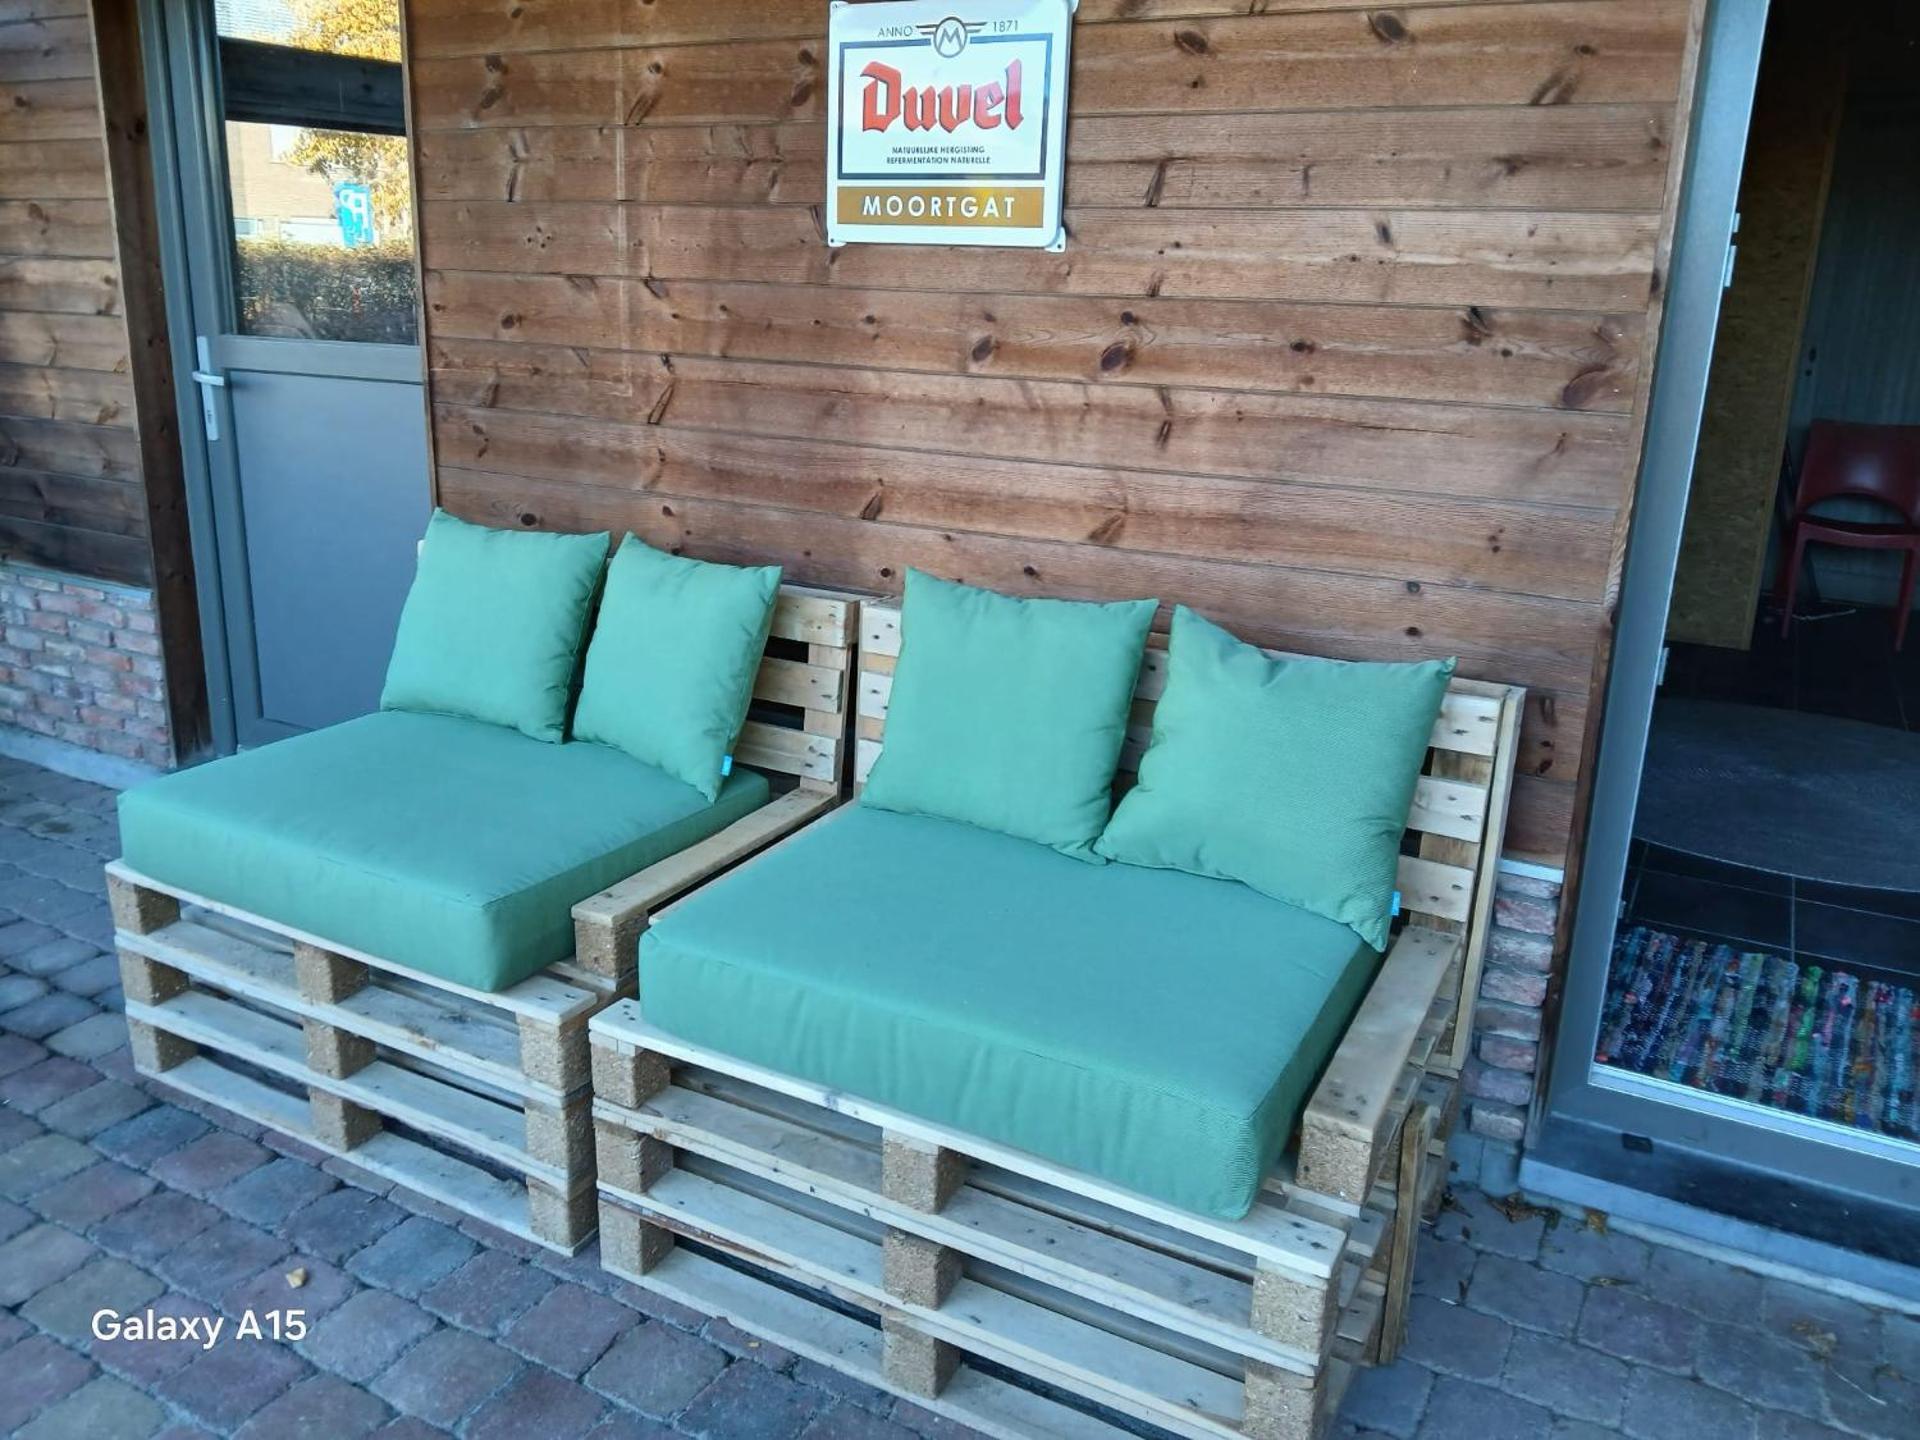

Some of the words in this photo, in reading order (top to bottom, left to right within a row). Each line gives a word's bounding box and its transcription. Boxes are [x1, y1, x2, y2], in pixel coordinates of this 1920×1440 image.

[878, 25, 914, 38] ANNO
[992, 20, 1019, 33] 1871
[860, 58, 1024, 133] Duvel
[886, 156, 949, 165] REFERMENTATION
[950, 156, 991, 164] NATURELLE
[862, 195, 1015, 218] MOORTGAT
